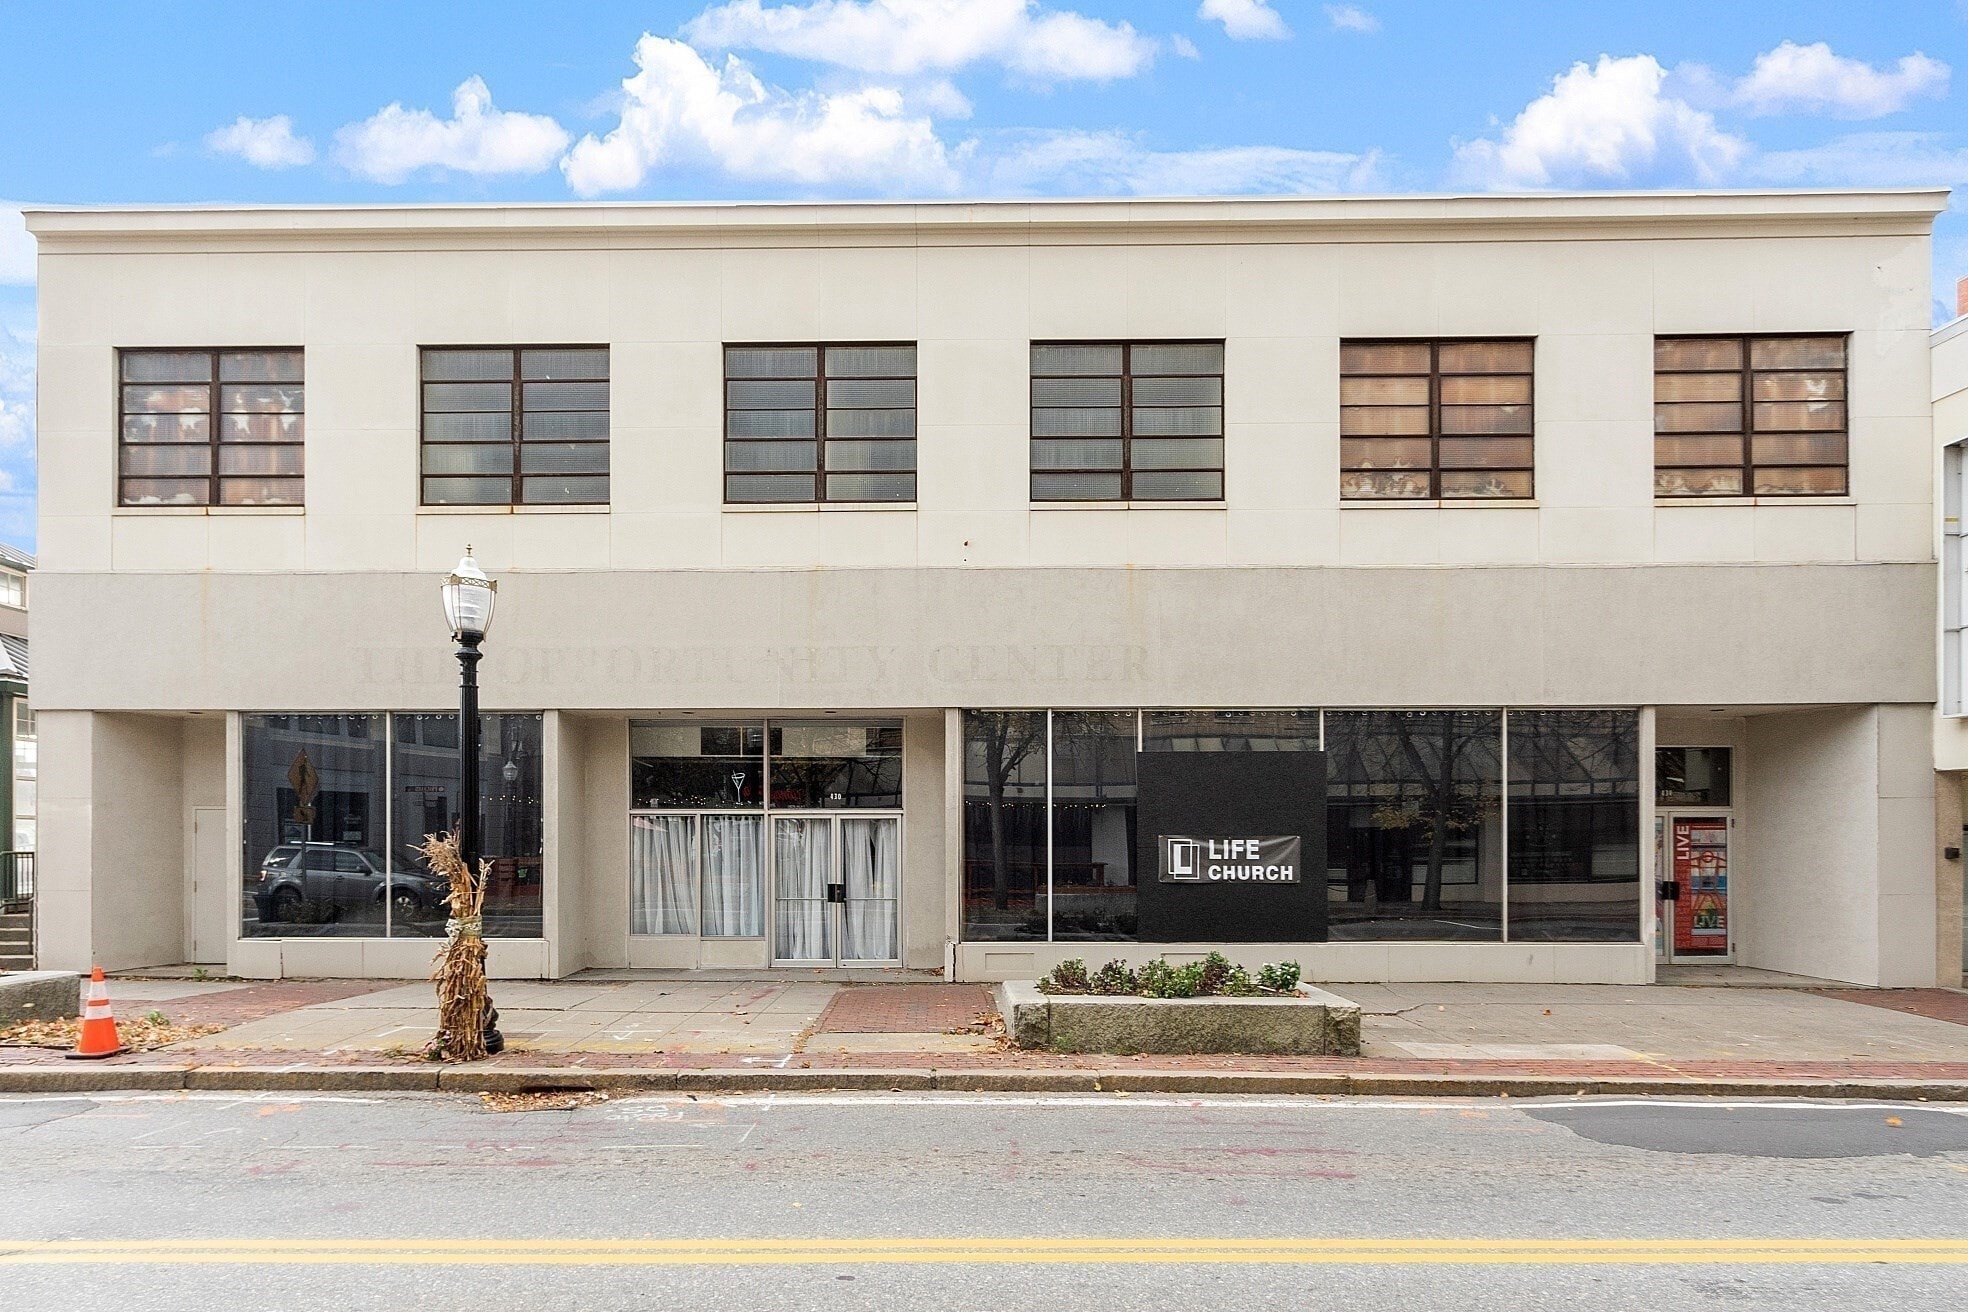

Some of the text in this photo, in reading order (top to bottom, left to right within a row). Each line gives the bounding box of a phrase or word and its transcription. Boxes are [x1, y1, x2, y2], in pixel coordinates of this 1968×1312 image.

[928, 645, 1153, 683] CENTER
[1208, 839, 1260, 860] LIFE
[1677, 826, 1689, 860] LIVE
[1207, 865, 1293, 881] CHURCH
